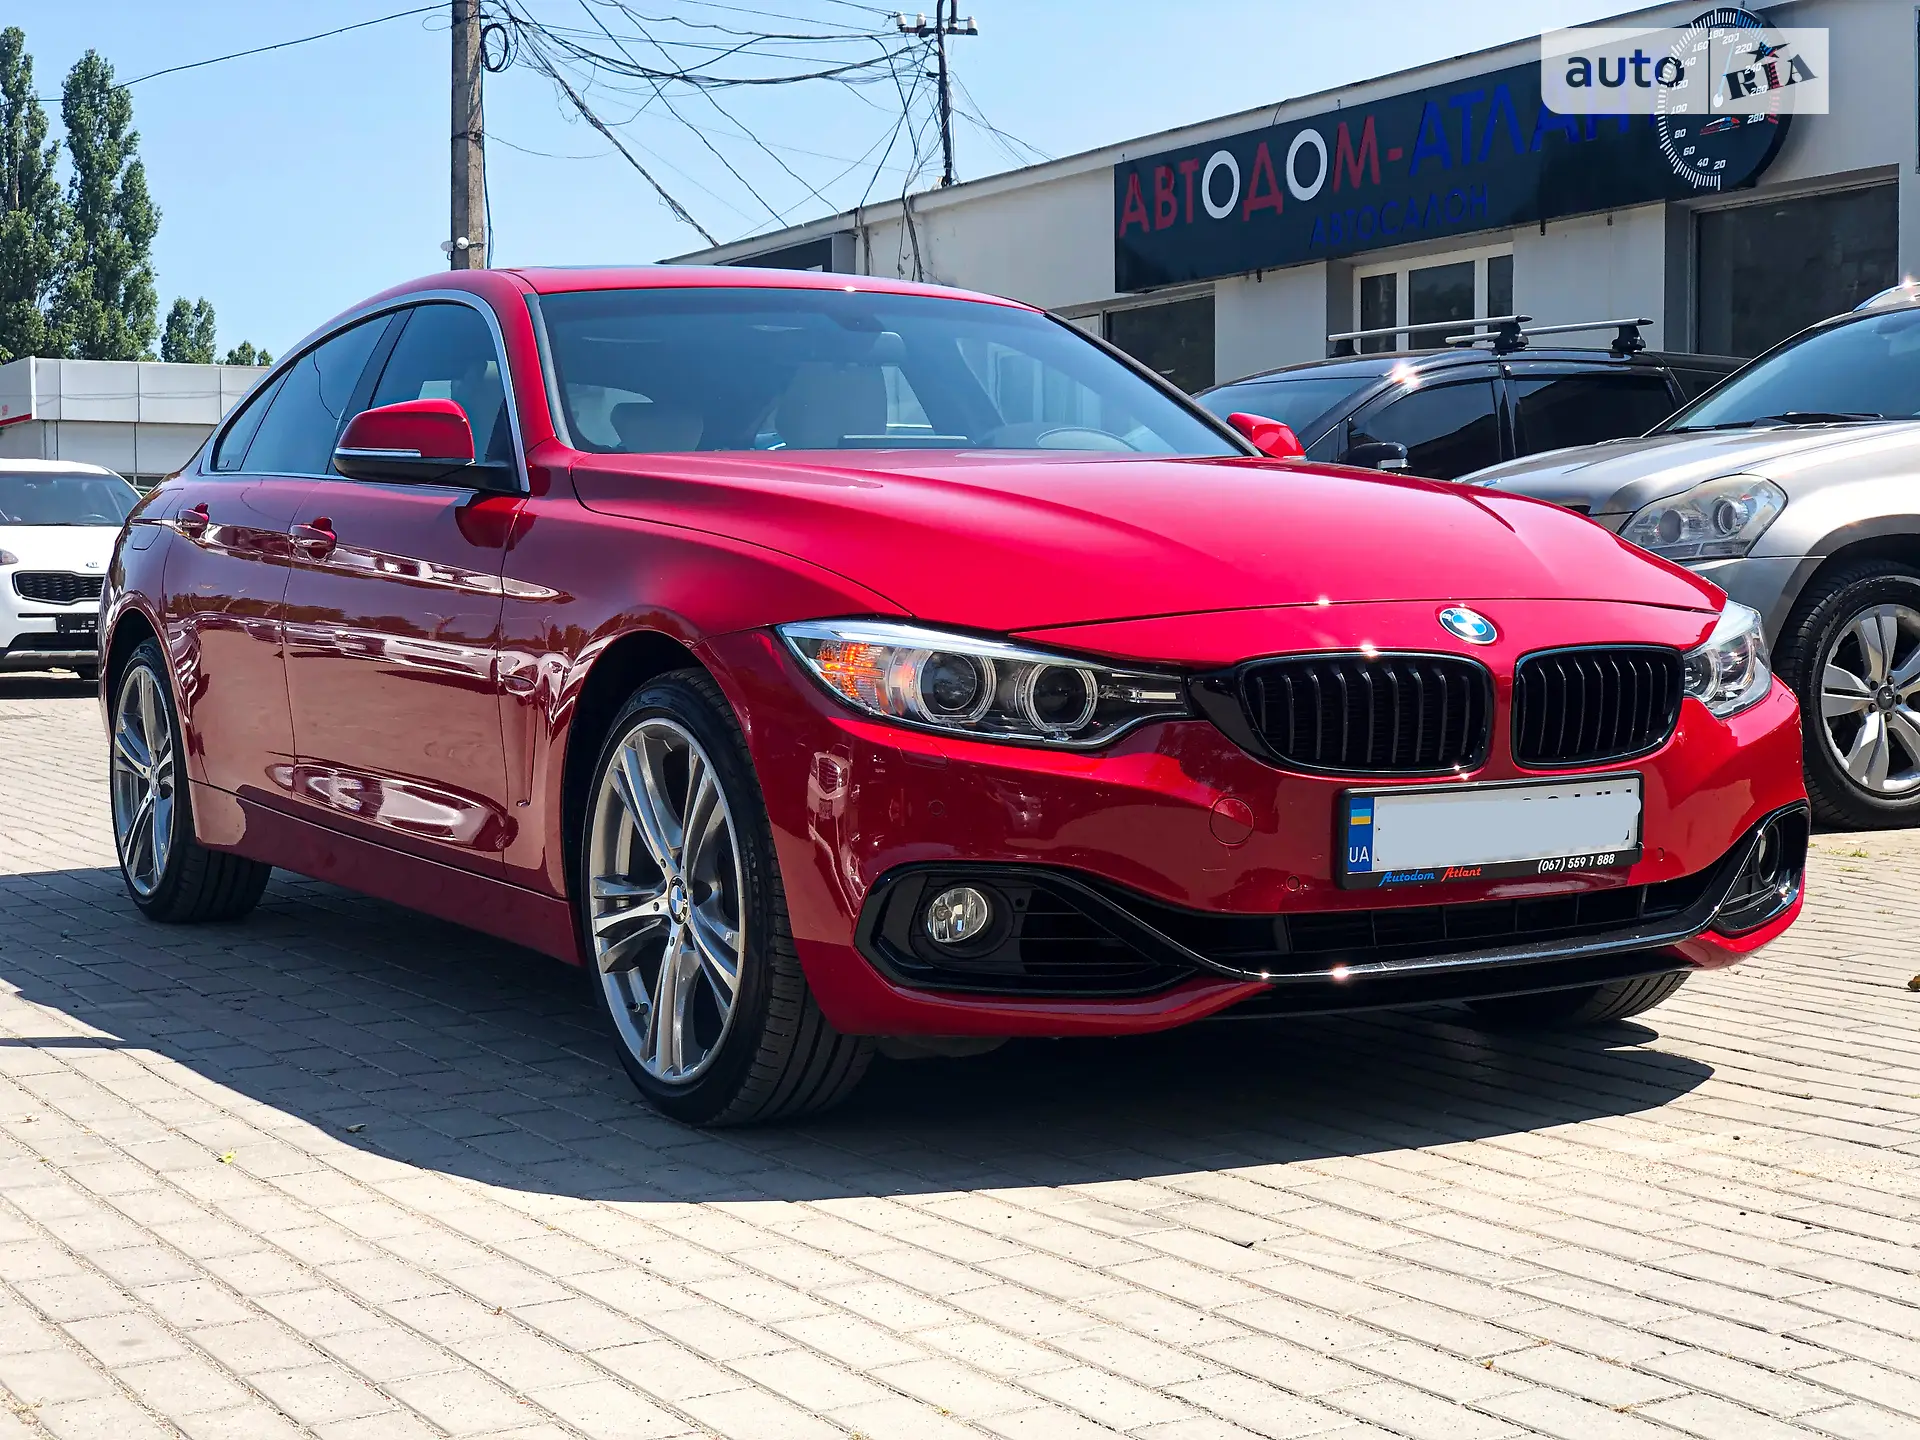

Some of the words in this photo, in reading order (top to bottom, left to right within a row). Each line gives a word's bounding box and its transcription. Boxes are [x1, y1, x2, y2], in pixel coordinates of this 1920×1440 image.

[1722, 33, 1740, 45] 200
[1734, 42, 1752, 55] 220
[1670, 103, 1688, 115] 100
[1674, 128, 1687, 139] 80
[1683, 145, 1696, 156] 60
[1696, 157, 1709, 168] 40
[1713, 159, 1727, 170] 20
[1309, 182, 1488, 250] АВТОСАЛОН
[1348, 845, 1370, 863] UA
[1379, 870, 1435, 887] Autodom
[1440, 865, 1482, 882] Atlant
[1537, 858, 1565, 875] (067)
[1567, 856, 1586, 869] 559
[1596, 853, 1615, 866] 888
